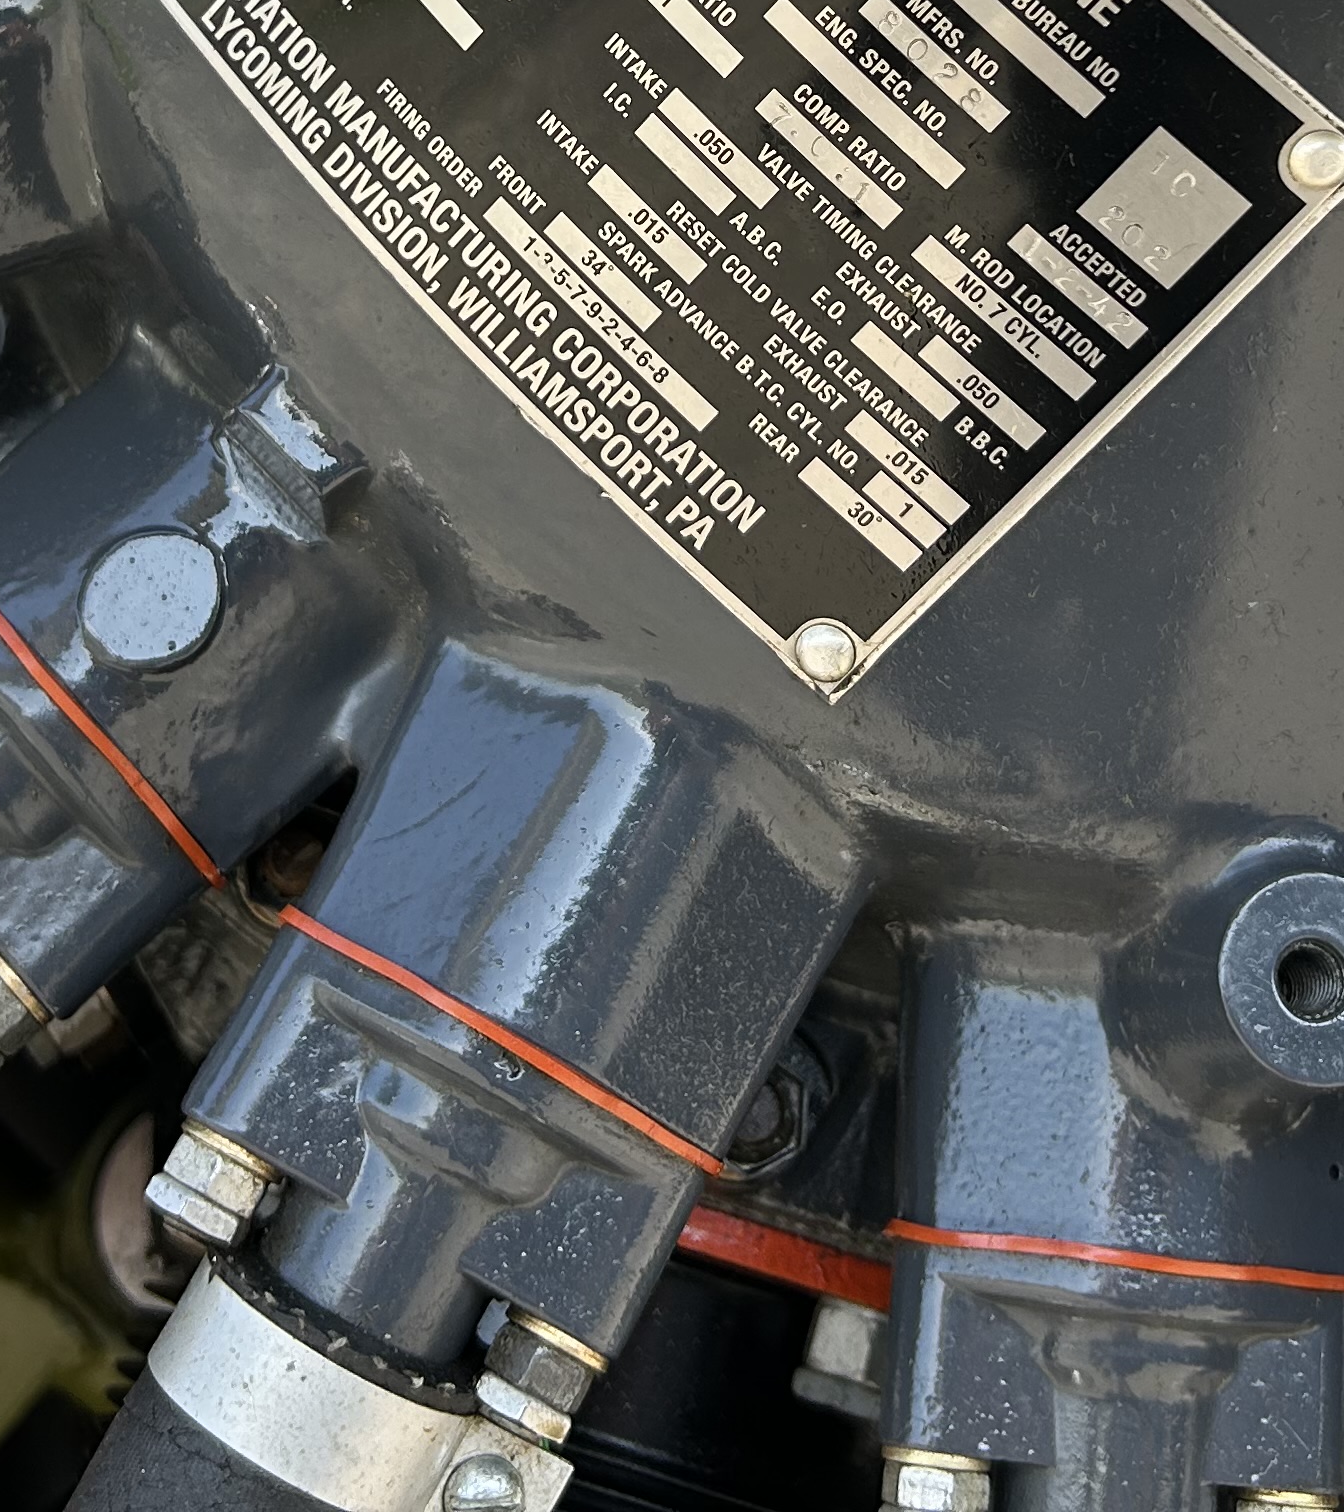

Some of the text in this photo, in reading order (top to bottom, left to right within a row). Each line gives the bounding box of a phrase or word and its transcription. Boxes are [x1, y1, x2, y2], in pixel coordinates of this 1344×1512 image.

[603, 31, 735, 165] INTAKE .050
[813, 4, 947, 138] ENG. SPEC. NO.
[872, 5, 988, 117] 8028
[964, 46, 999, 86] NO.
[1084, 54, 1120, 93] NO.
[375, 77, 431, 141] FIRING
[426, 134, 483, 198] ORDER
[486, 153, 547, 215] FRONT
[535, 108, 670, 244] INTAKE .015
[601, 81, 782, 267] I.C. A.B.C.
[792, 83, 906, 191] COMP. RATIO
[322, 79, 558, 338] MANUFACTURING
[551, 326, 766, 534] CORPORATION
[756, 141, 982, 354] VALVE TIMING CLEARANCE
[942, 223, 1107, 369] M. ROD LOCATION
[1048, 223, 1147, 307] ACCEPTED
[321, 140, 450, 294] DIVISION,
[446, 274, 673, 512] WILLIAMSPORT,
[664, 494, 716, 551] PA
[597, 220, 659, 284] SPARK
[652, 278, 741, 361] ADVANCE
[734, 353, 785, 408] B.T.C.
[785, 401, 823, 446] CYL.
[825, 437, 859, 475] NO.
[664, 199, 930, 448] RESET COLD VALVE CLEARANCE
[809, 284, 1008, 471] E.O. B.B.C.
[834, 260, 1000, 409] EXHAUST .050
[953, 272, 1041, 359] NO. 7 CYL.
[747, 411, 800, 464] REAR
[761, 332, 930, 485] EXHAUST .015
